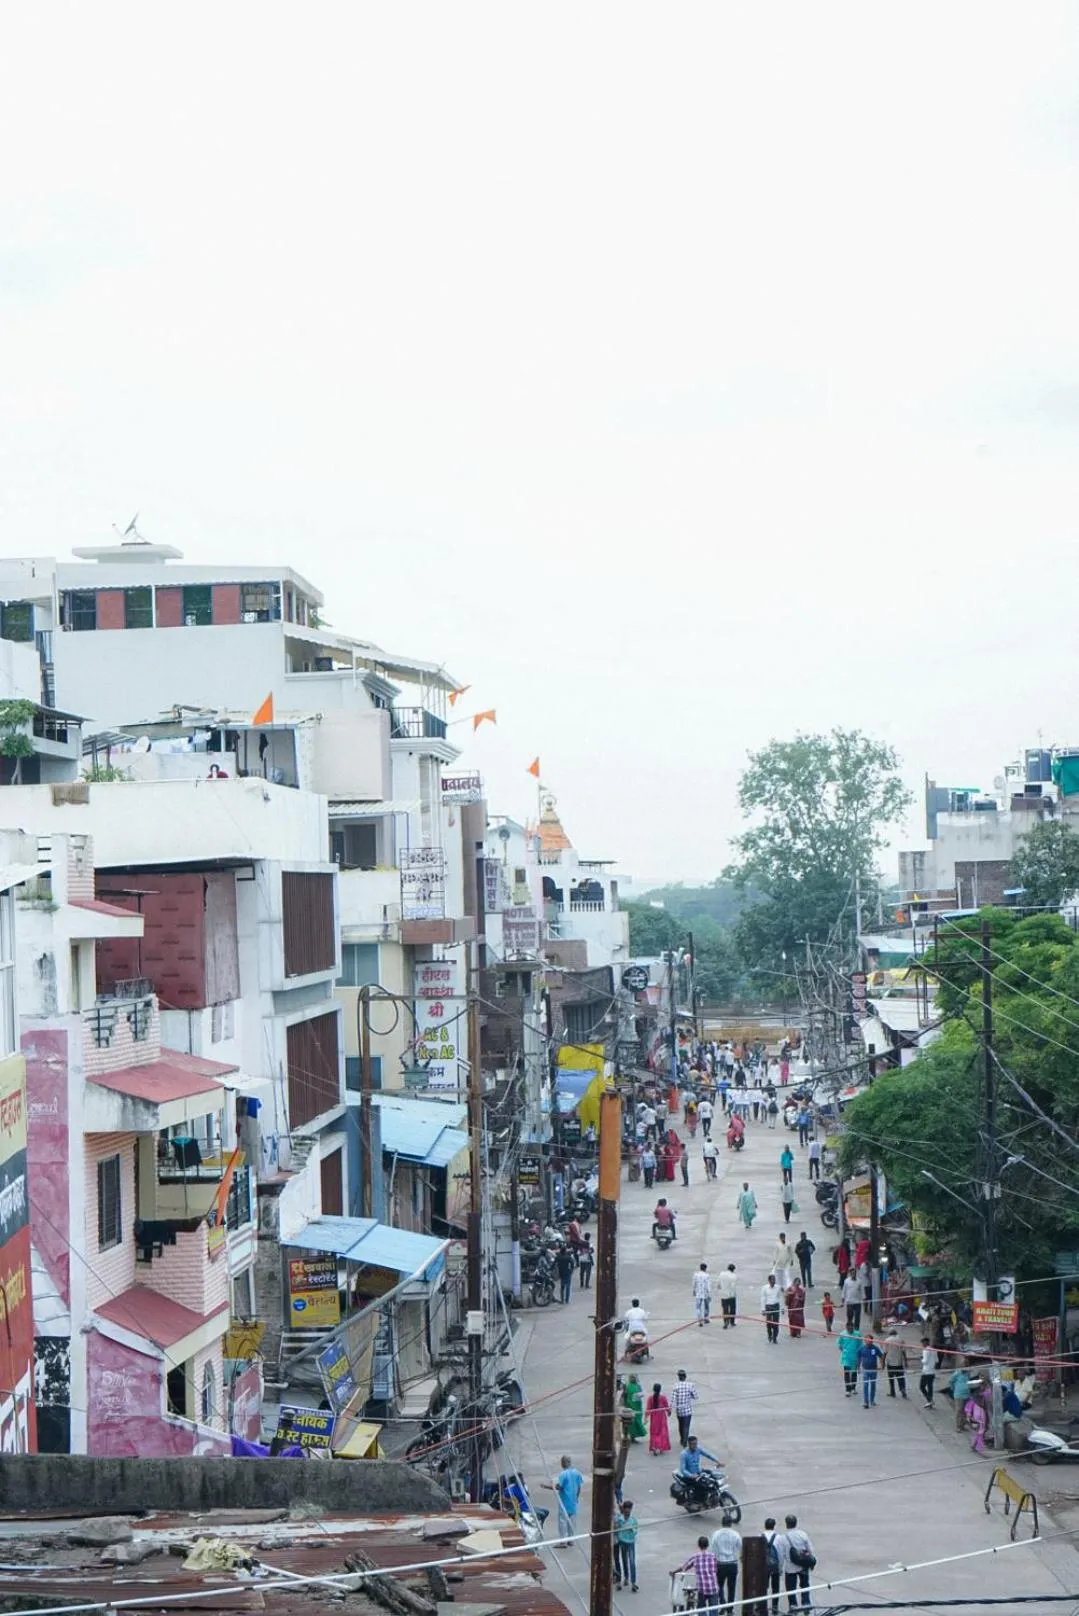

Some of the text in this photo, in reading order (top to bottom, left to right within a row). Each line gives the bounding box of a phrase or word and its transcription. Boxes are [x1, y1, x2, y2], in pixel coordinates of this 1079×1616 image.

[502, 907, 535, 918] HOTEL
[440, 1045, 455, 1059] AC
[293, 1415, 328, 1429] नायक
